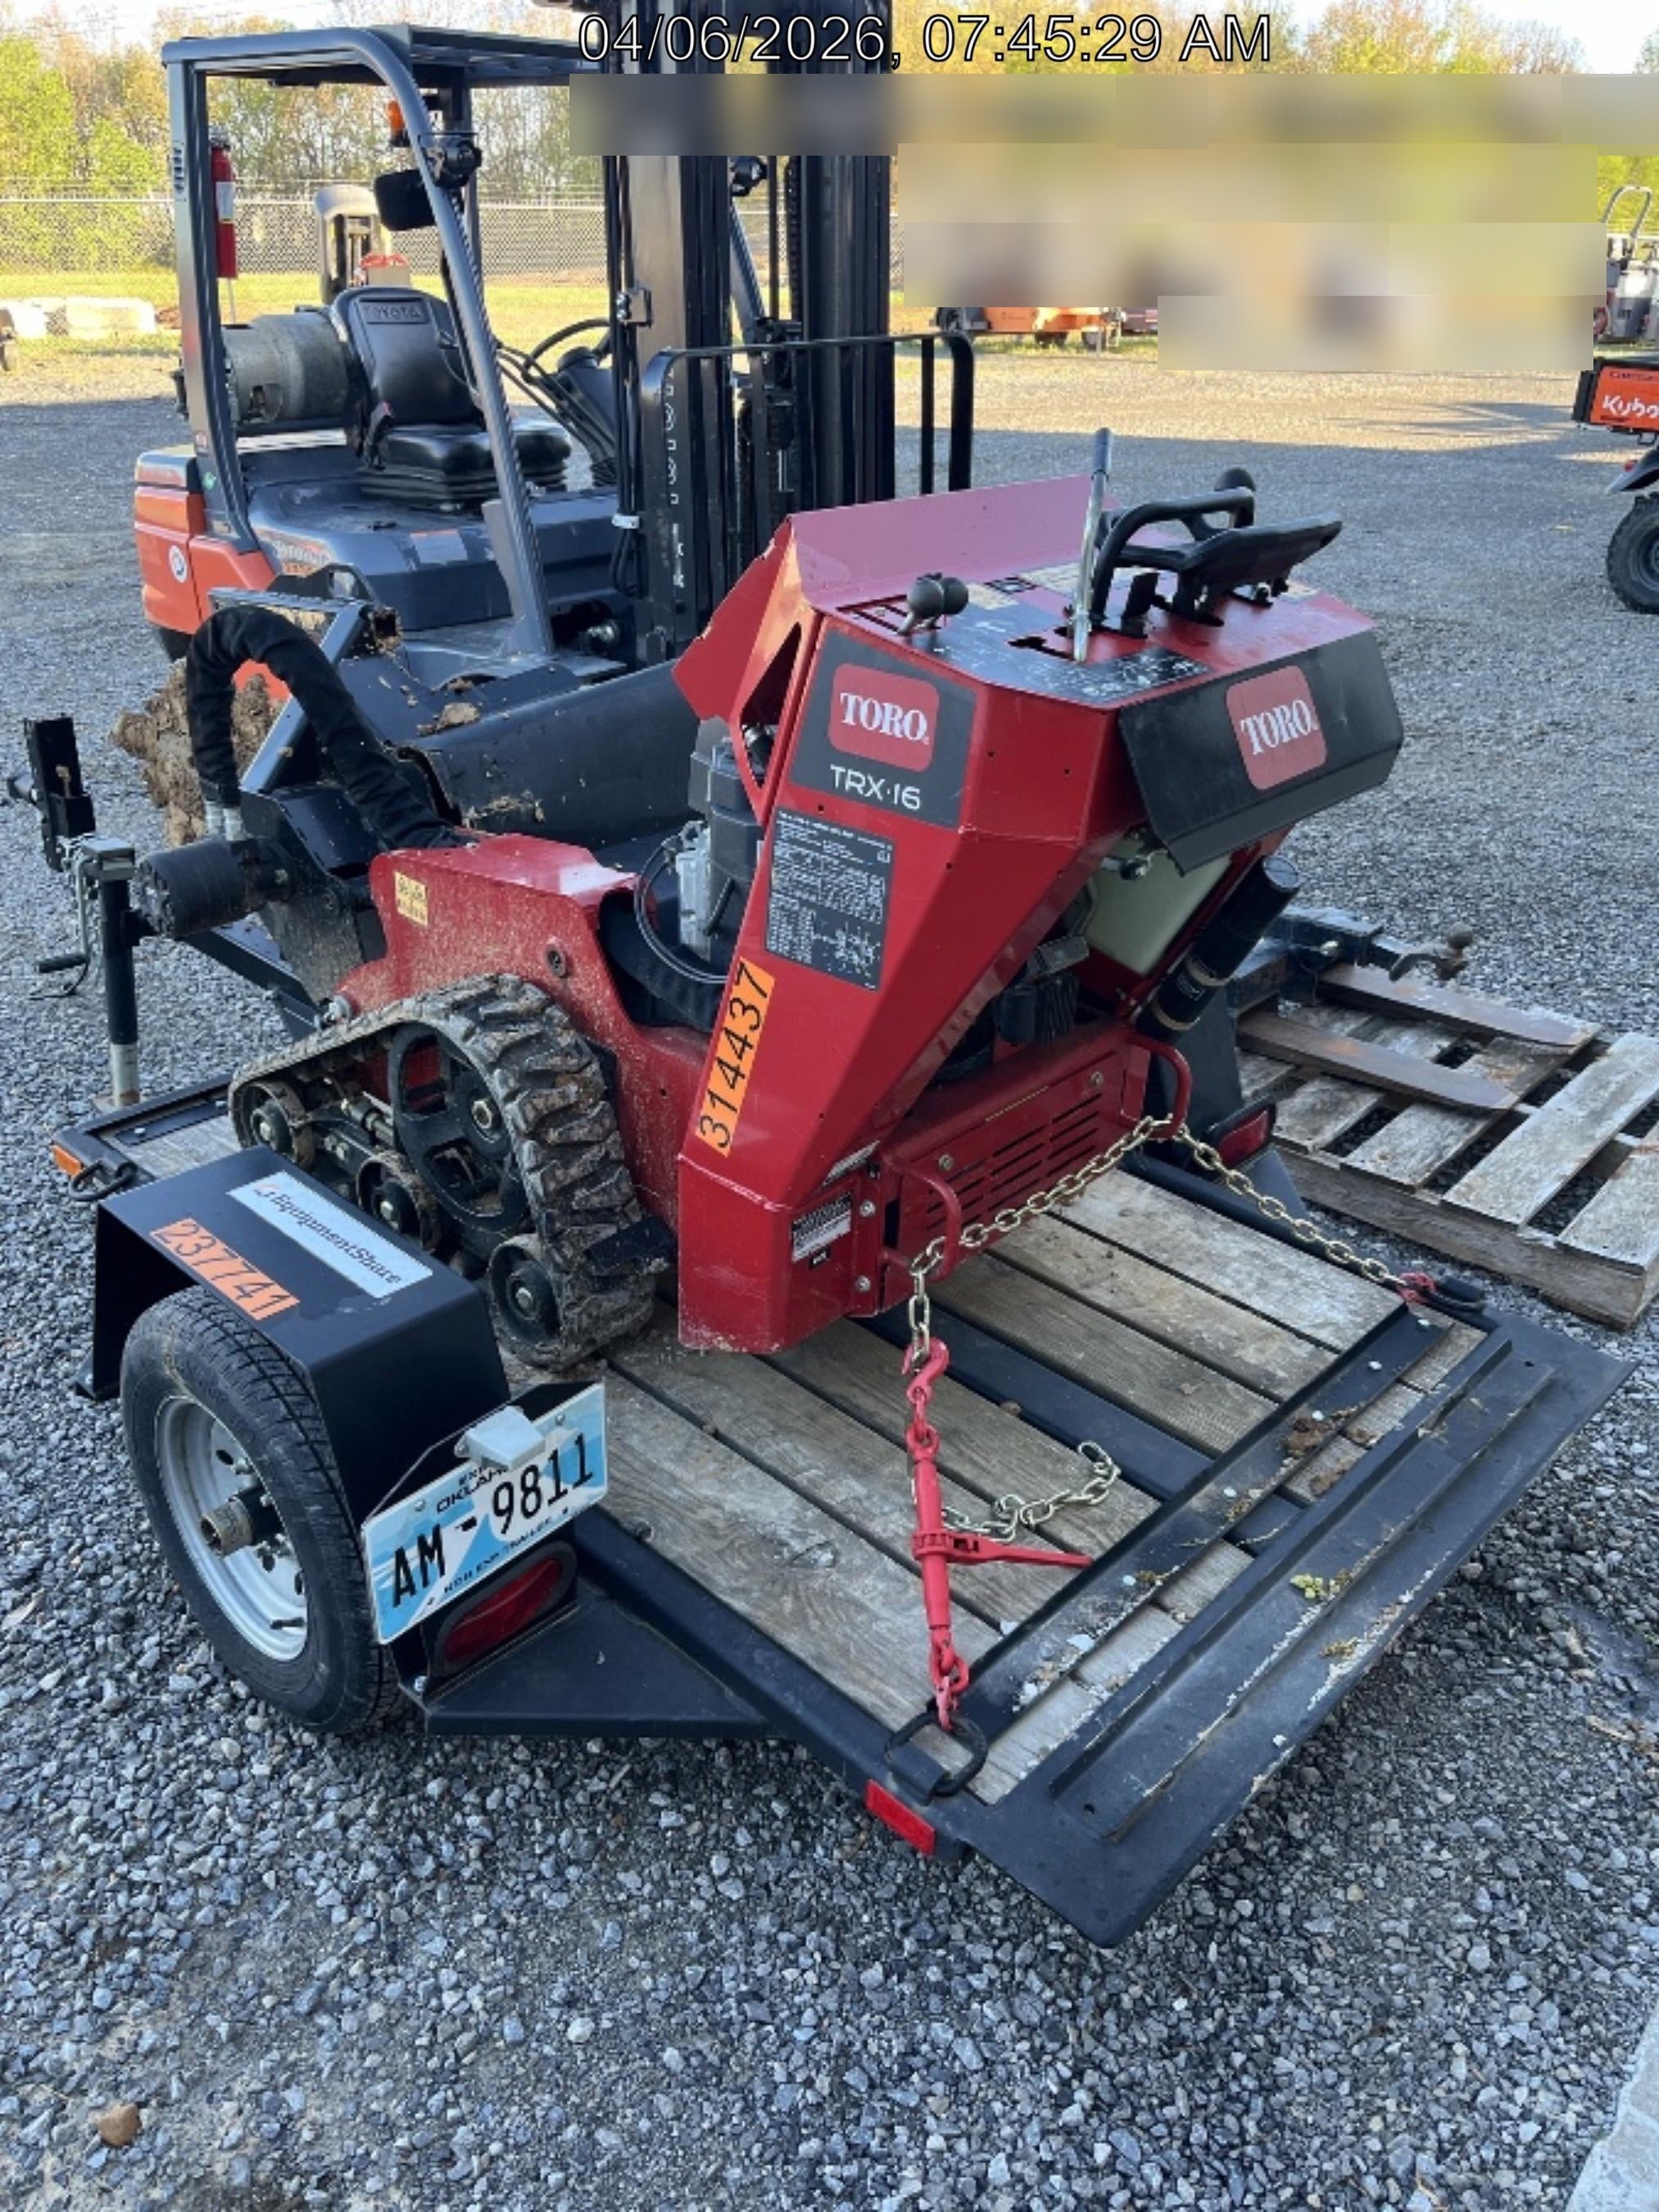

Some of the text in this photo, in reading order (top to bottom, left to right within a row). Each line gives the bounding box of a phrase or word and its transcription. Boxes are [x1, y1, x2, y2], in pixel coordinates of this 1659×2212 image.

[1602, 395, 1659, 419] Kubo
[840, 691, 928, 742] TORO
[1240, 699, 1312, 755] TORO
[699, 961, 768, 1149] 314437
[156, 1222, 285, 1314] 237741
[270, 1193, 402, 1284] EquipmentShare
[392, 1432, 593, 1608] AM 9811
[437, 1468, 508, 1514] OKLAH
